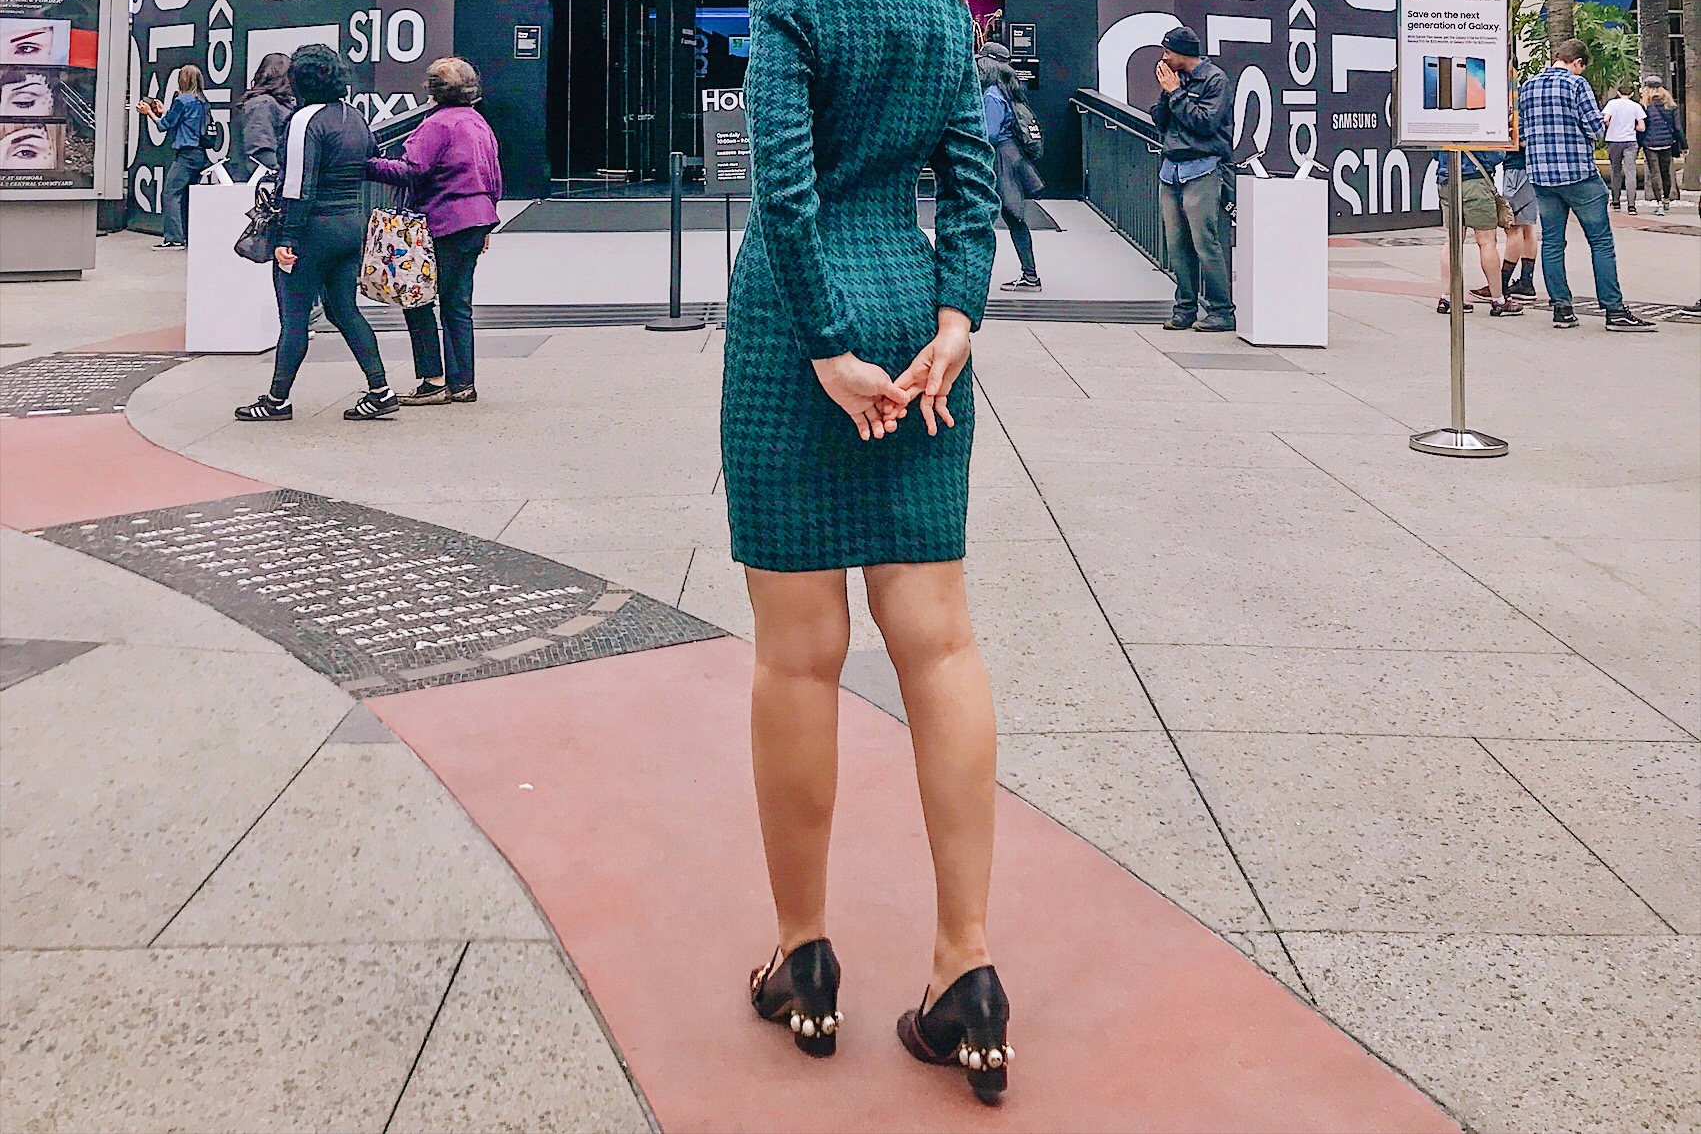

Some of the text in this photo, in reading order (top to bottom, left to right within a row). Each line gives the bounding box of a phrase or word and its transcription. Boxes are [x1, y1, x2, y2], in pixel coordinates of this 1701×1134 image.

[1407, 10, 1429, 19] Save
[1444, 11, 1459, 19] the
[1460, 11, 1480, 20] next
[1407, 21, 1501, 33] generation of Galaxy.
[348, 8, 426, 63] S10
[1332, 113, 1378, 129] SAMSUNG
[729, 131, 740, 139] daily
